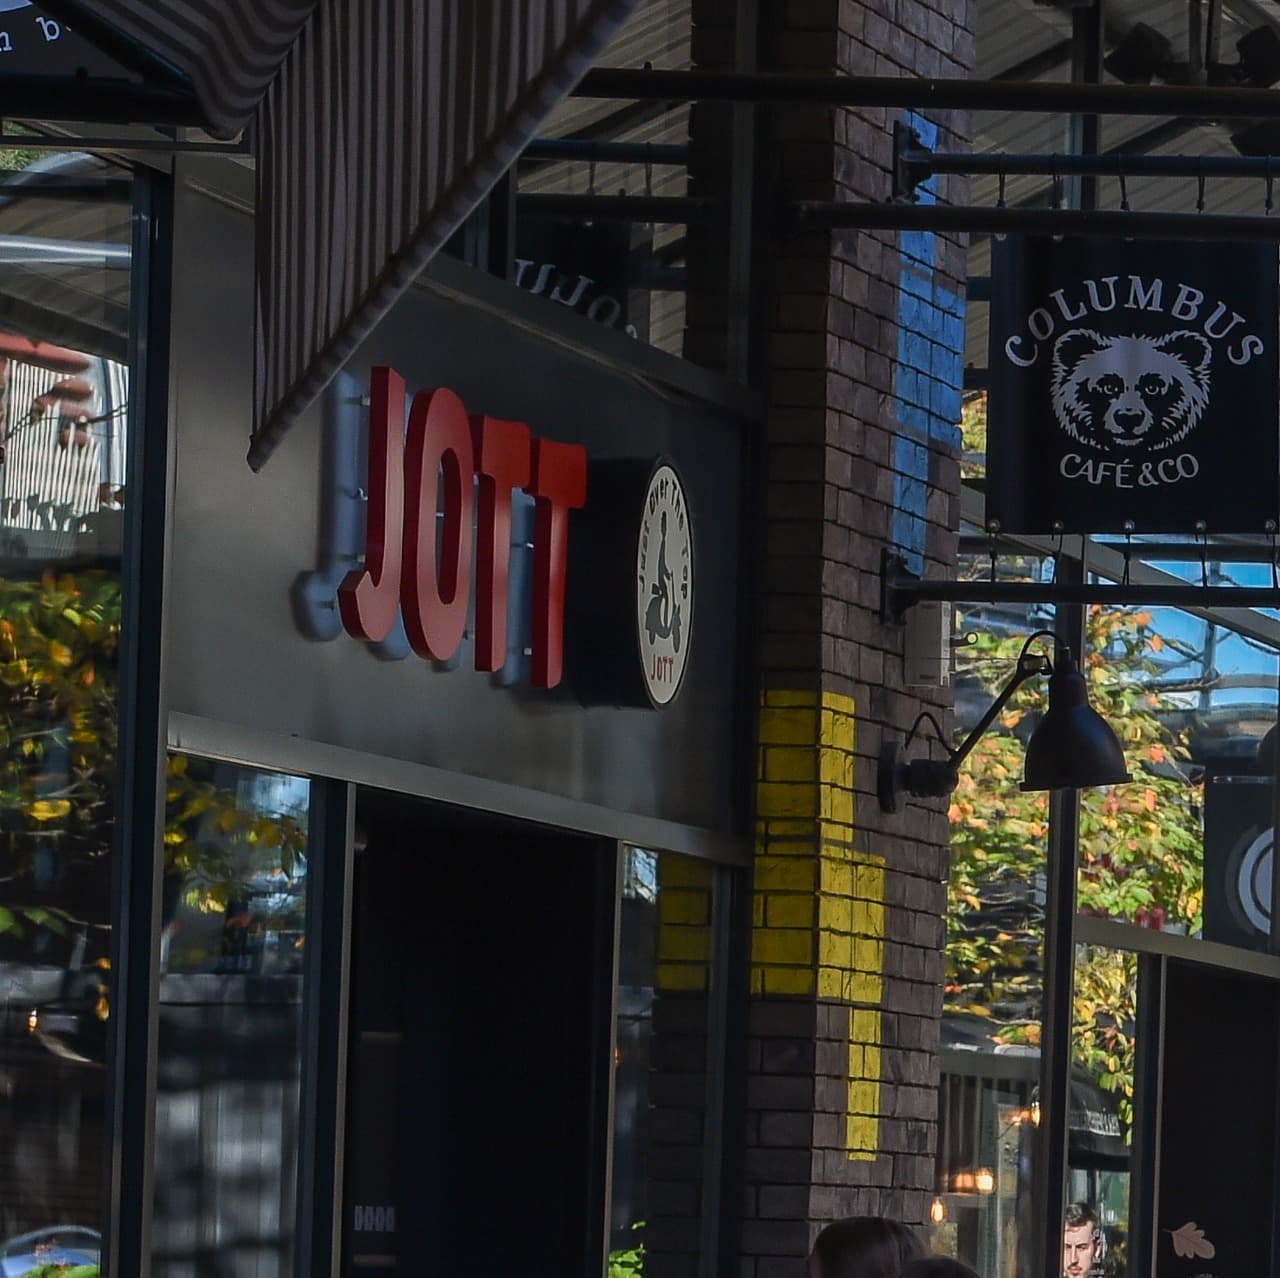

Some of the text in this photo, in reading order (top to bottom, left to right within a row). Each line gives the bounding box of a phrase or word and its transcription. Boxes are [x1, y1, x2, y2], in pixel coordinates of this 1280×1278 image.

[1003, 273, 1265, 368] COLUMBUS
[338, 366, 588, 689] JOTT
[671, 478, 684, 532] The
[650, 653, 674, 684] JOTT
